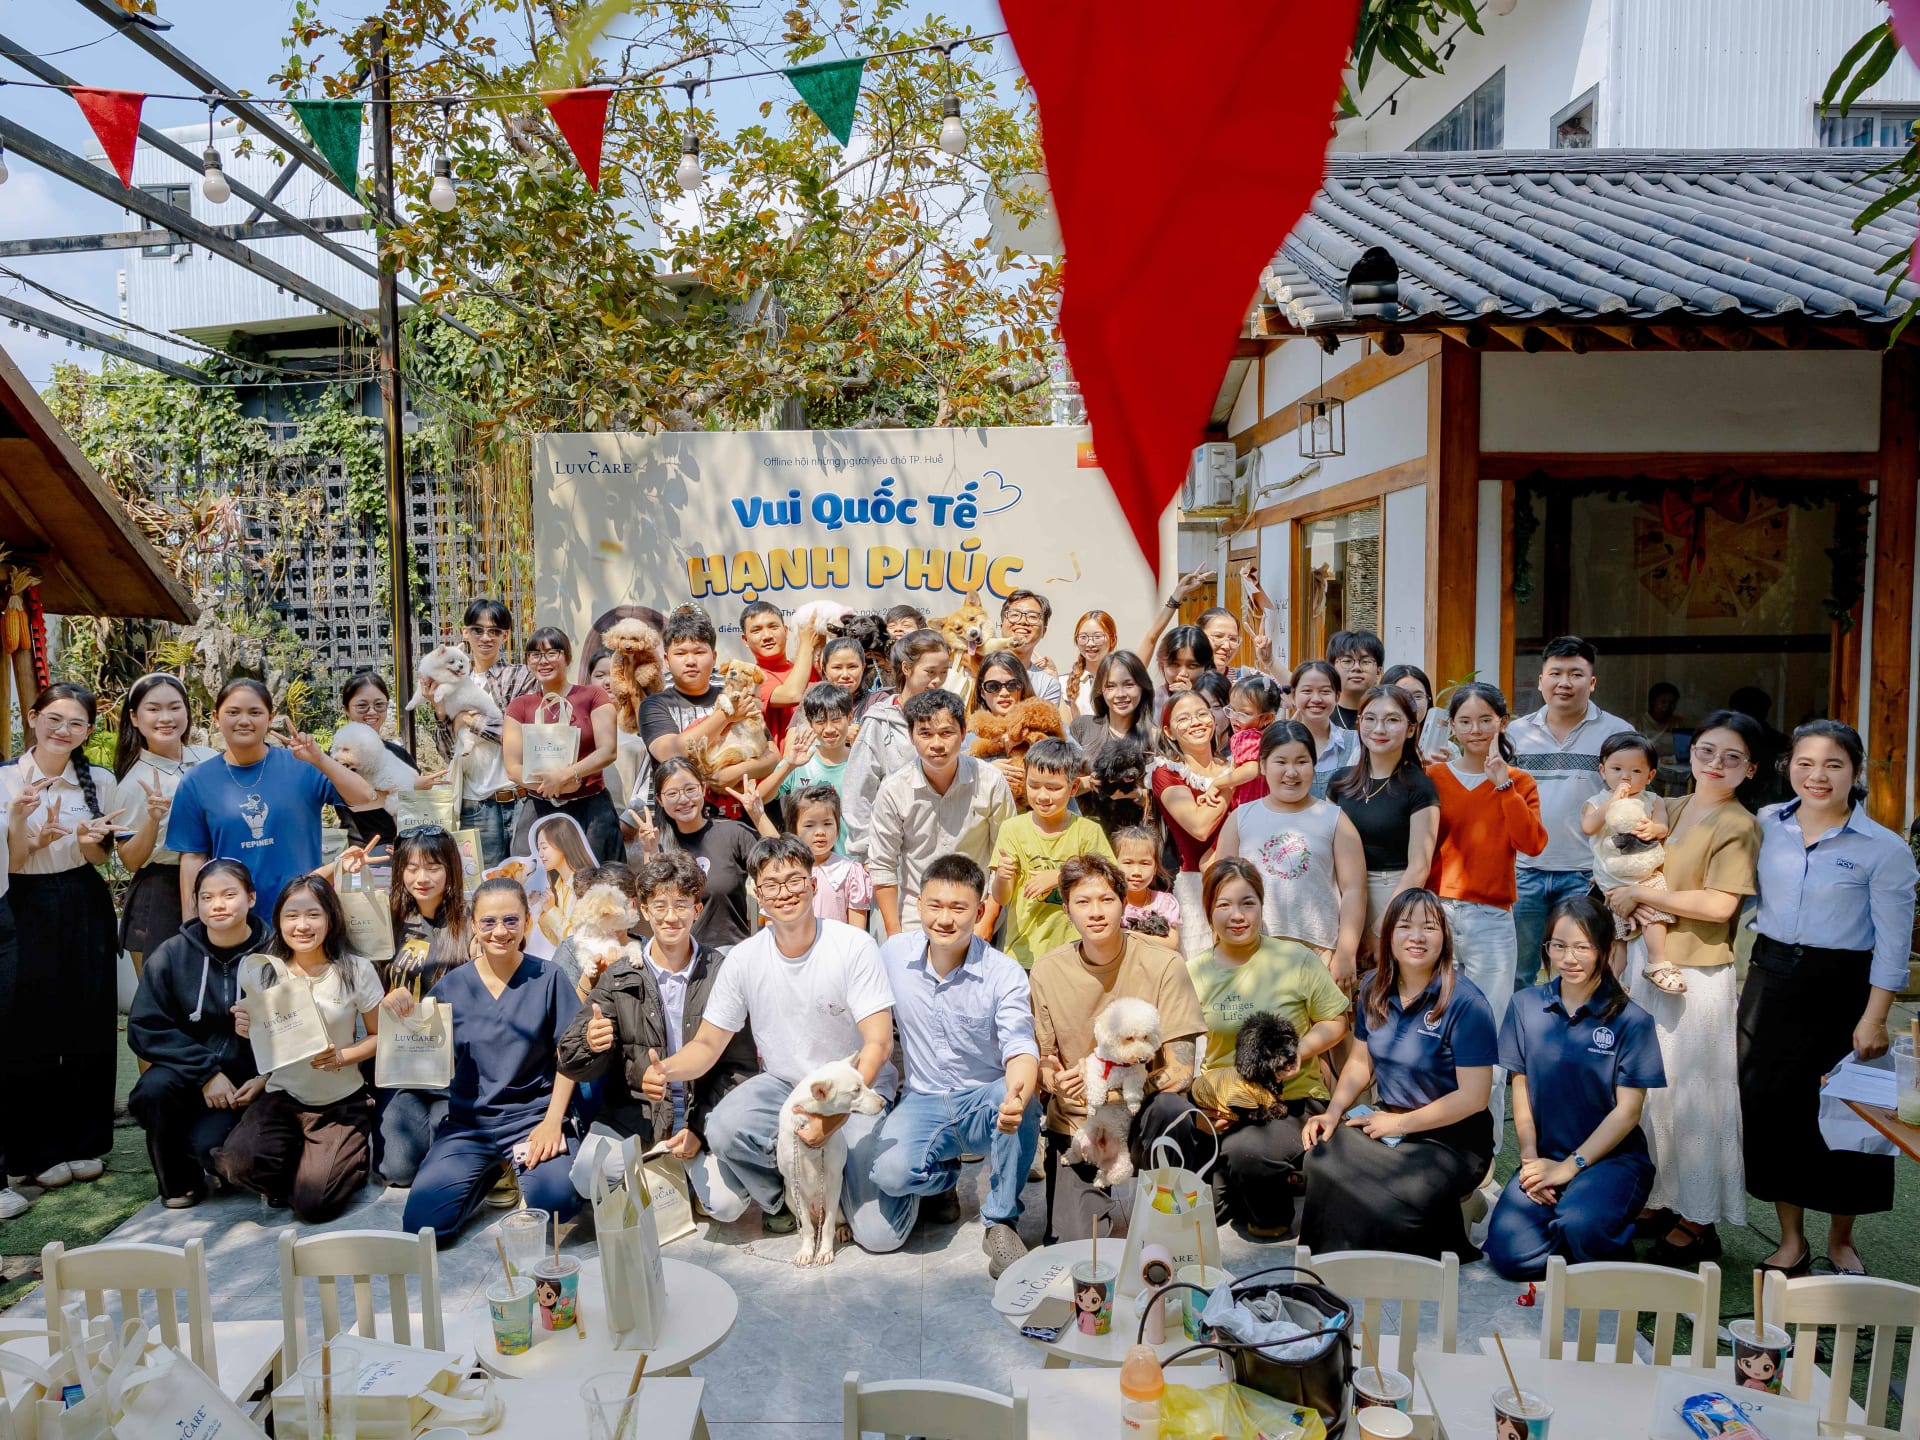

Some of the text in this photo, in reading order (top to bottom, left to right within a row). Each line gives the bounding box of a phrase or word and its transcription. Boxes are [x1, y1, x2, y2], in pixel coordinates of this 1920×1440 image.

[763, 457, 793, 467] Offline
[871, 455, 888, 468] yêu
[890, 455, 907, 465] chó
[909, 456, 922, 465] TP.
[924, 453, 944, 464] Huế
[732, 476, 979, 530] Vui Quốc Tế
[686, 536, 1024, 603] HẠNH PHÚC
[1224, 994, 1241, 1002] Art
[1212, 1002, 1254, 1012] Changes
